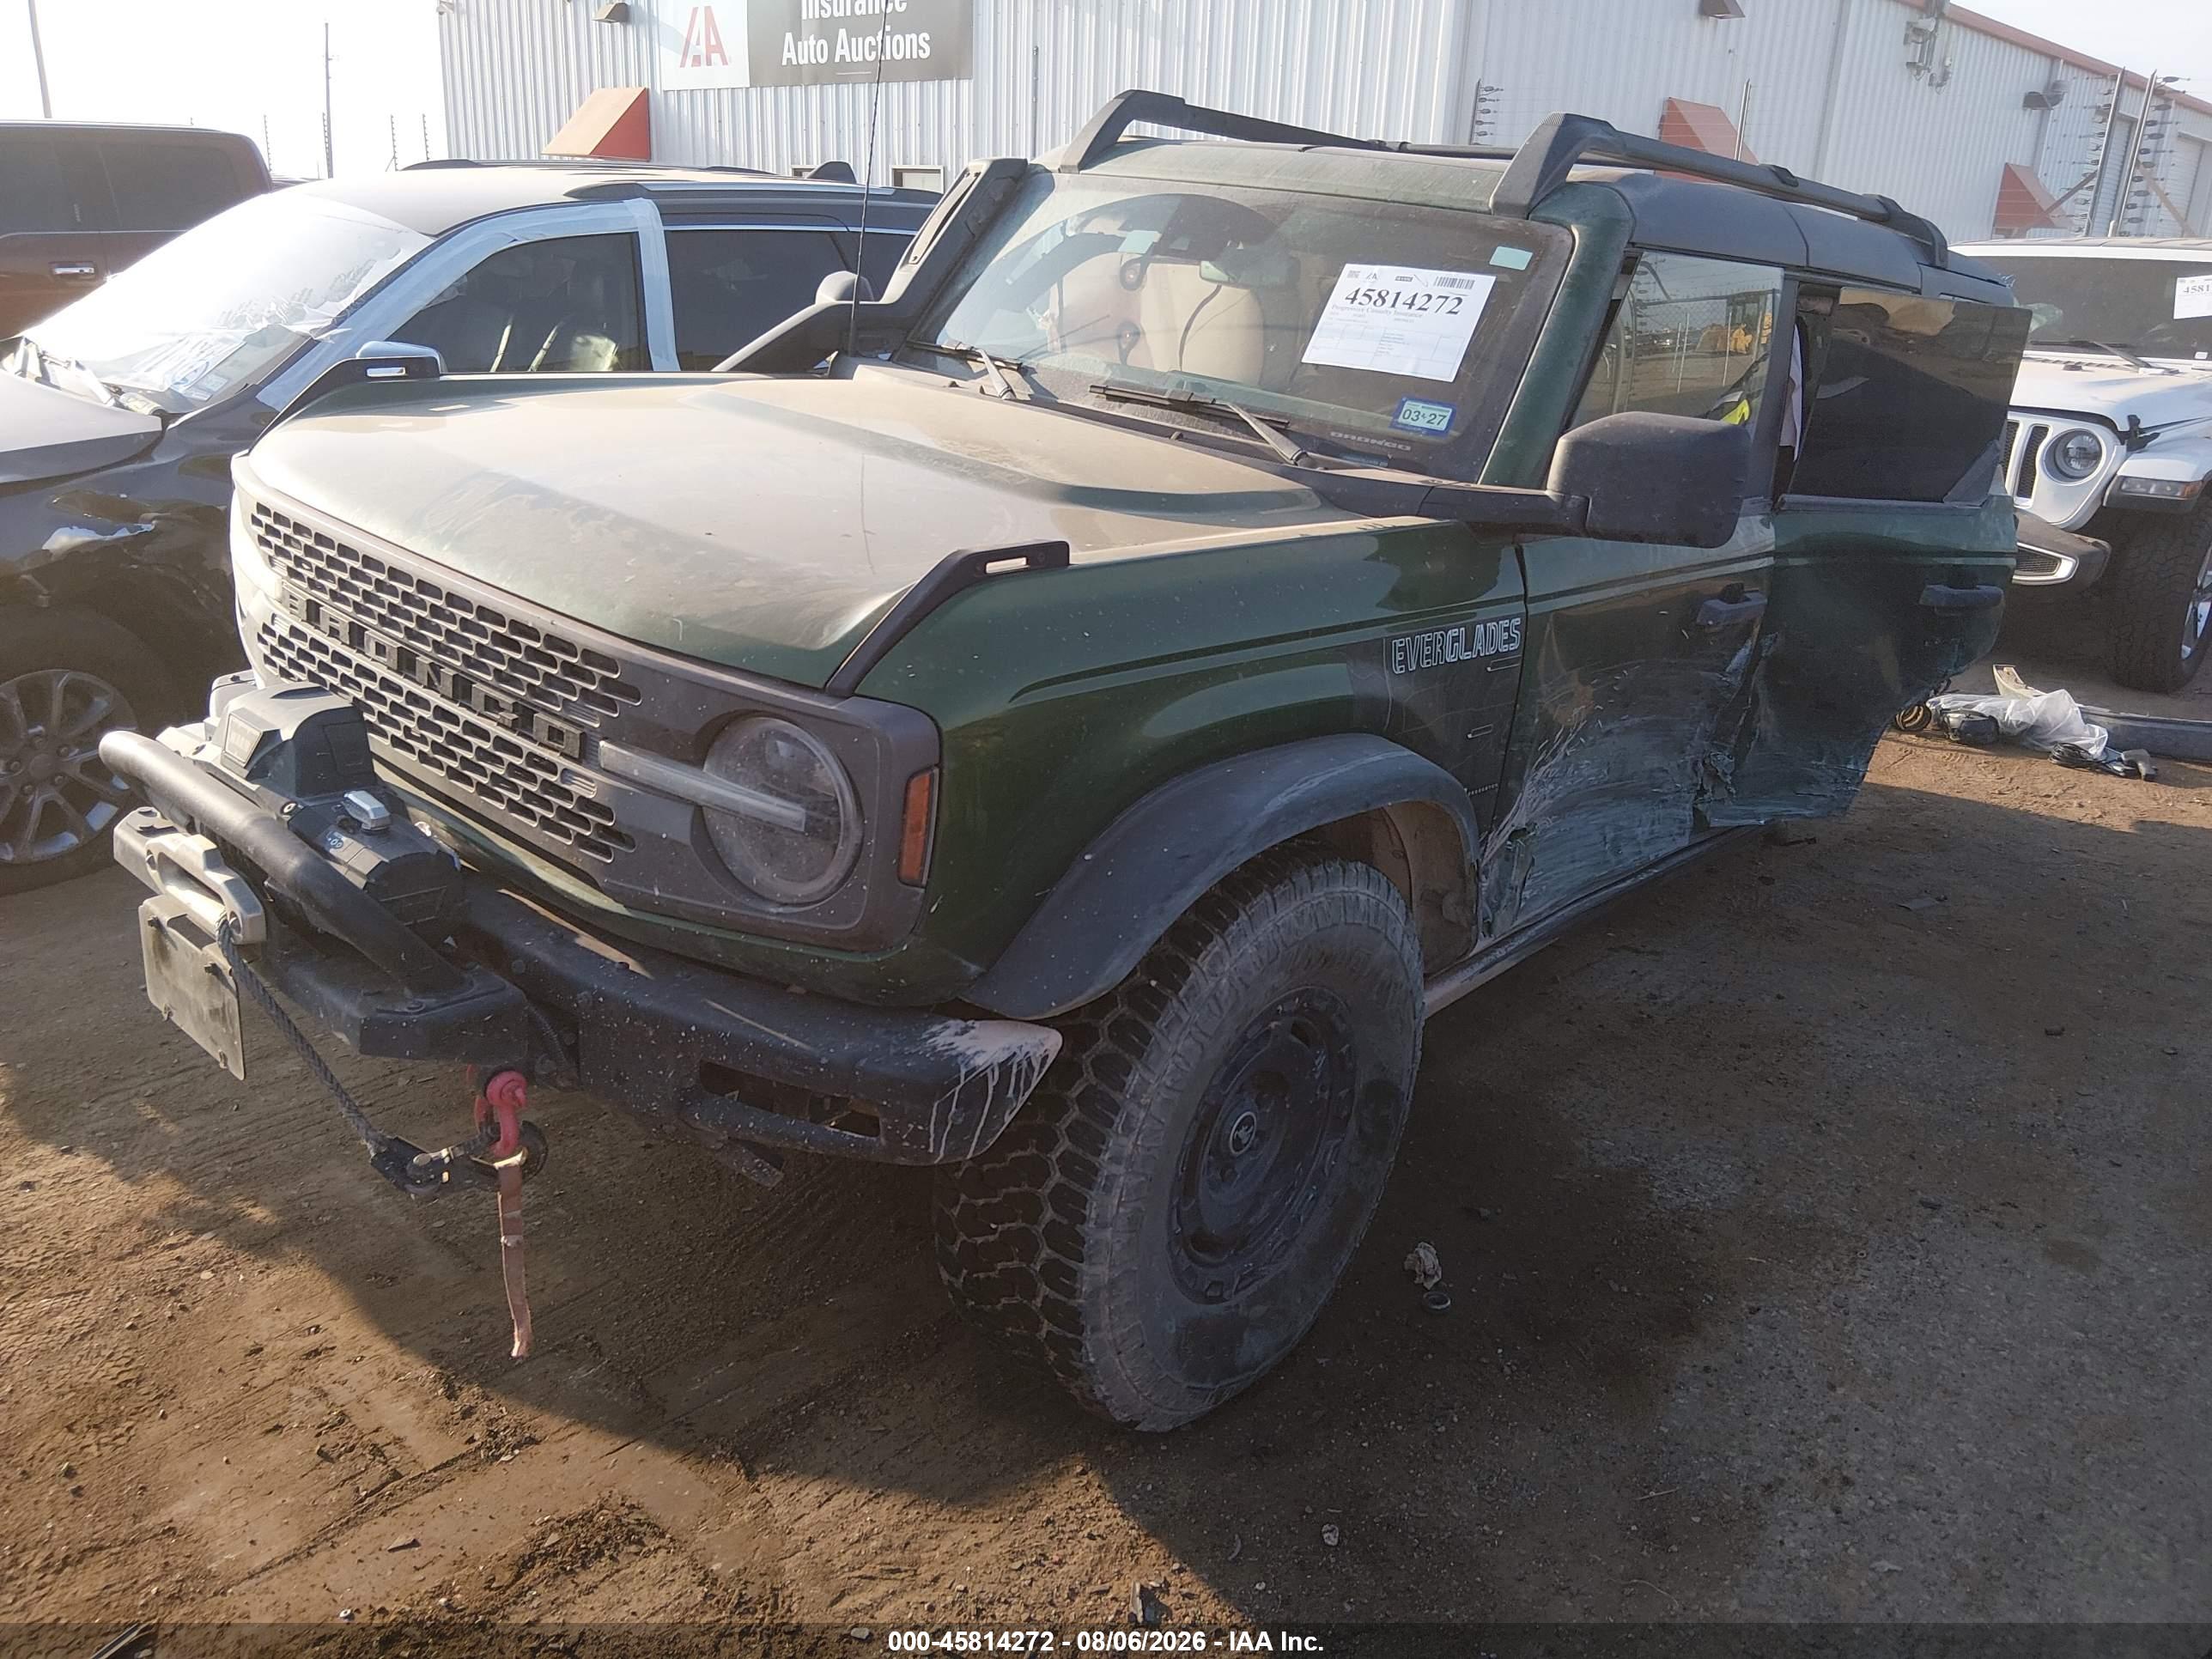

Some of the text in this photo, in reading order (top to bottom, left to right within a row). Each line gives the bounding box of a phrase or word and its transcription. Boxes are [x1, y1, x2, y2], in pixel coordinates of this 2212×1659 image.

[781, 25, 931, 65] Auto Auctions
[1345, 287, 1463, 315] 45814272
[1426, 413, 1447, 426] 27
[1391, 617, 1522, 675] EVERGLADES
[283, 581, 587, 759] BRONCO
